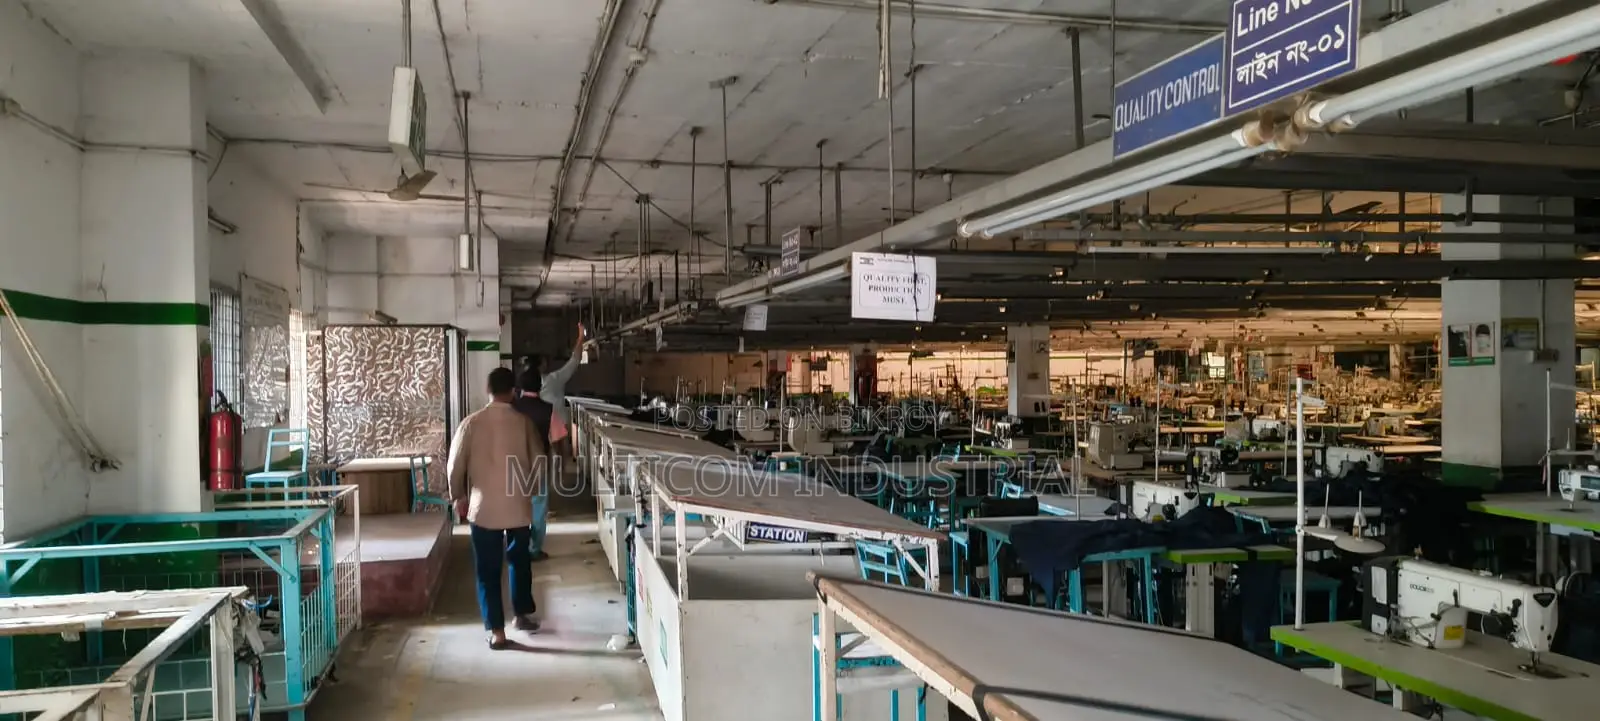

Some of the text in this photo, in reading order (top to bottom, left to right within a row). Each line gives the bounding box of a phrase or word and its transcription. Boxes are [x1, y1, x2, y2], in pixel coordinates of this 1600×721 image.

[1236, 1, 1278, 37] Line
[1235, 50, 1282, 85] লাইন
[1115, 62, 1220, 132] QUALITY CONTROL
[863, 274, 900, 283] QUALITY
[750, 525, 804, 542] STATION
